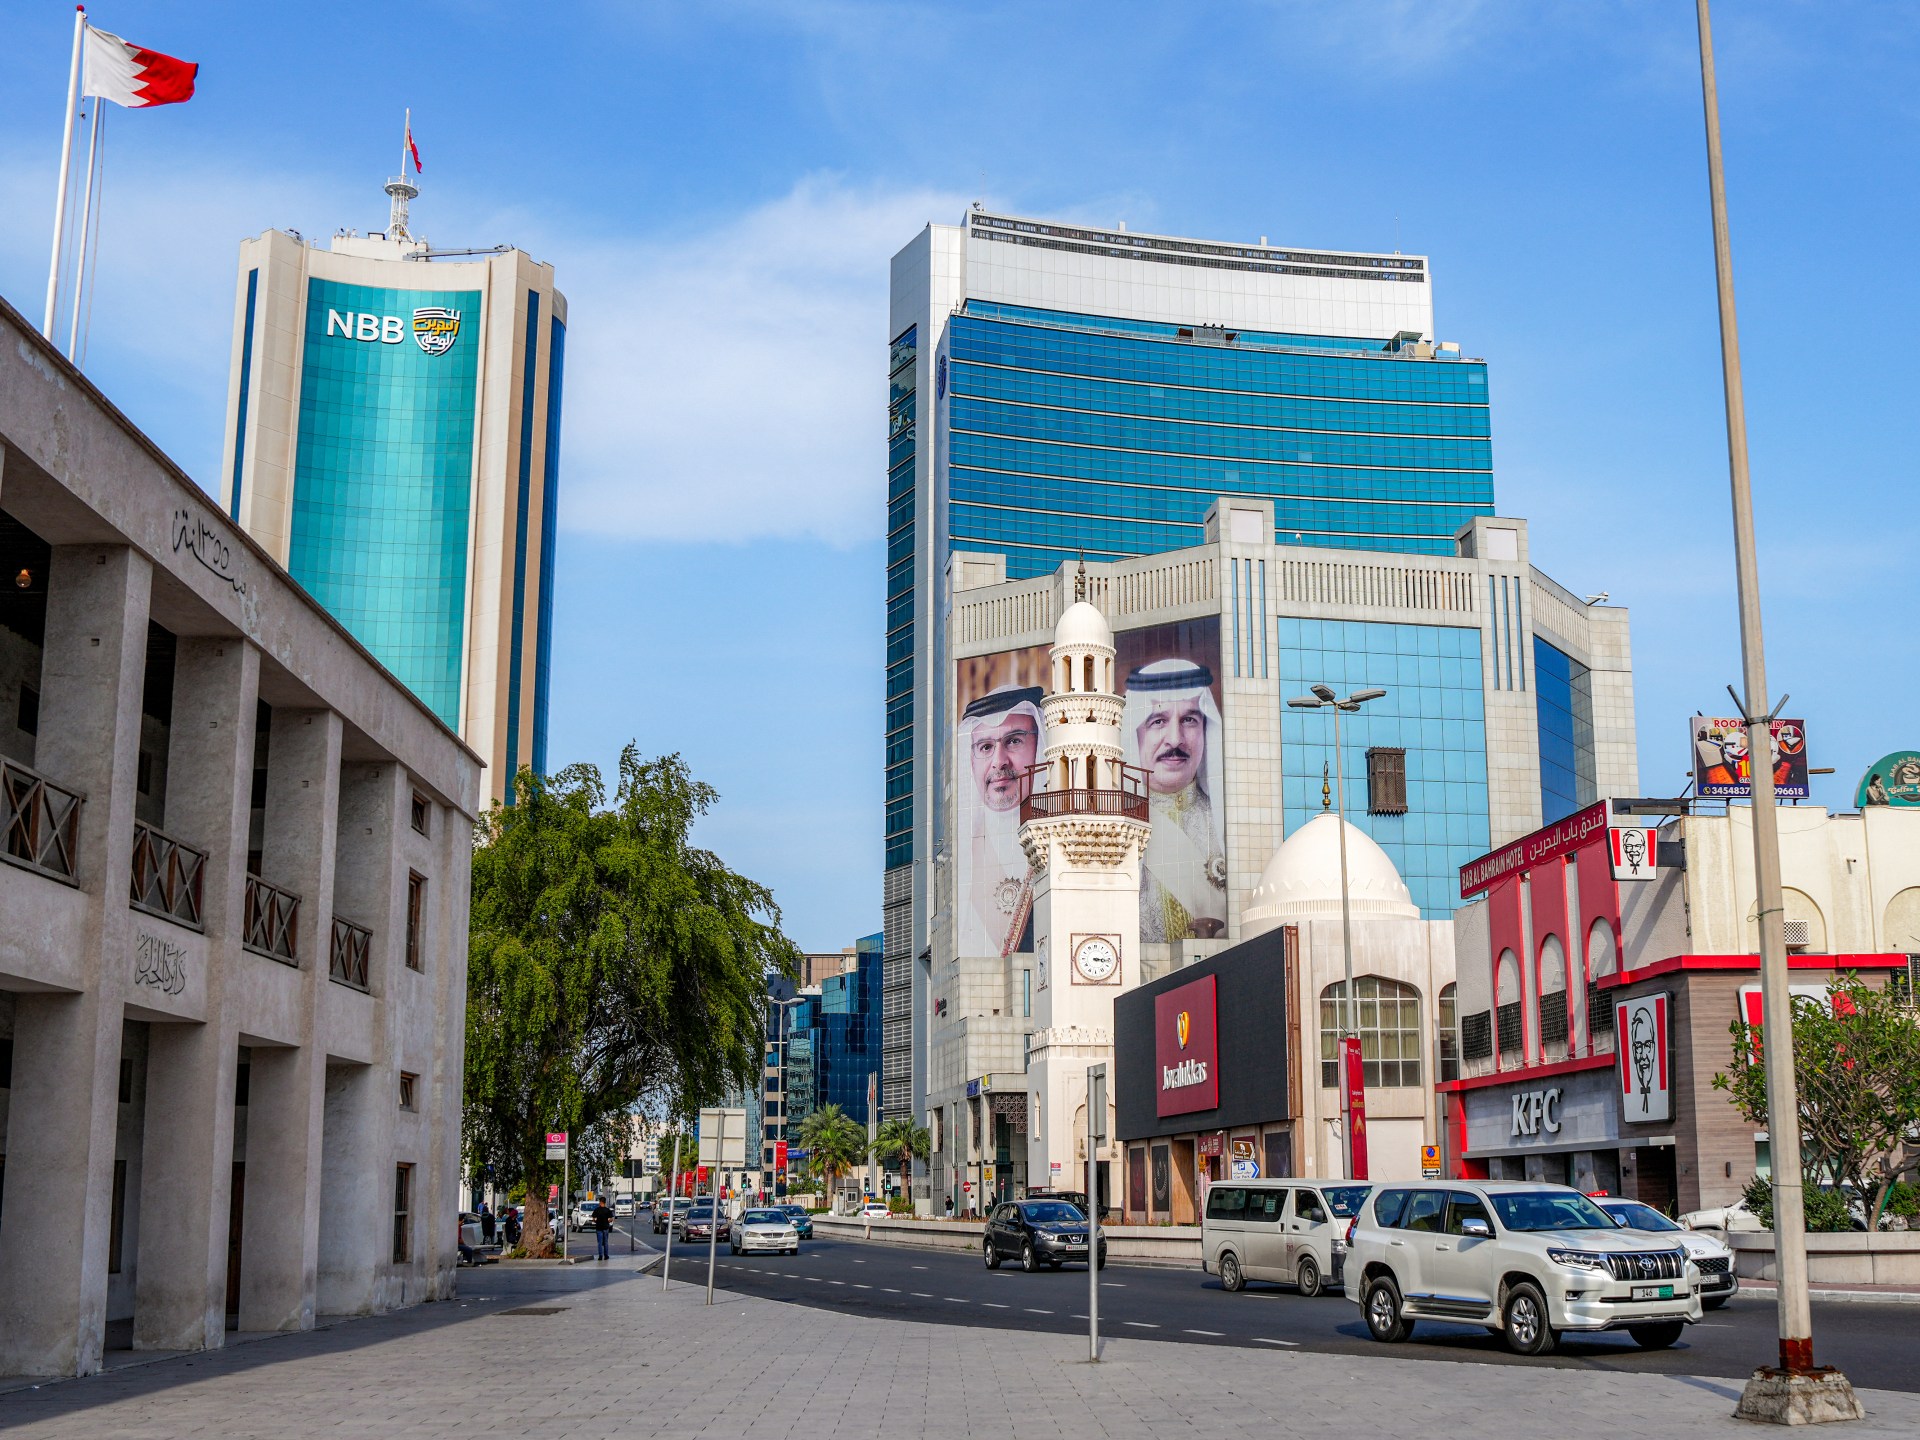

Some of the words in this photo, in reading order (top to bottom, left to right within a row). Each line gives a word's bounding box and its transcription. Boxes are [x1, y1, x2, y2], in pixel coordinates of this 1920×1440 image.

[326, 308, 405, 344] NBB
[1711, 786, 1750, 795] 3454837
[1562, 821, 1578, 846] باب
[1579, 808, 1604, 840] فندق
[1529, 827, 1561, 860] البحرين
[1462, 869, 1473, 890] BAB
[1473, 867, 1481, 886] AL
[1480, 855, 1505, 882] BAHRAIN
[1505, 845, 1524, 871] HOTEL
[1511, 1088, 1561, 1136] KFC
